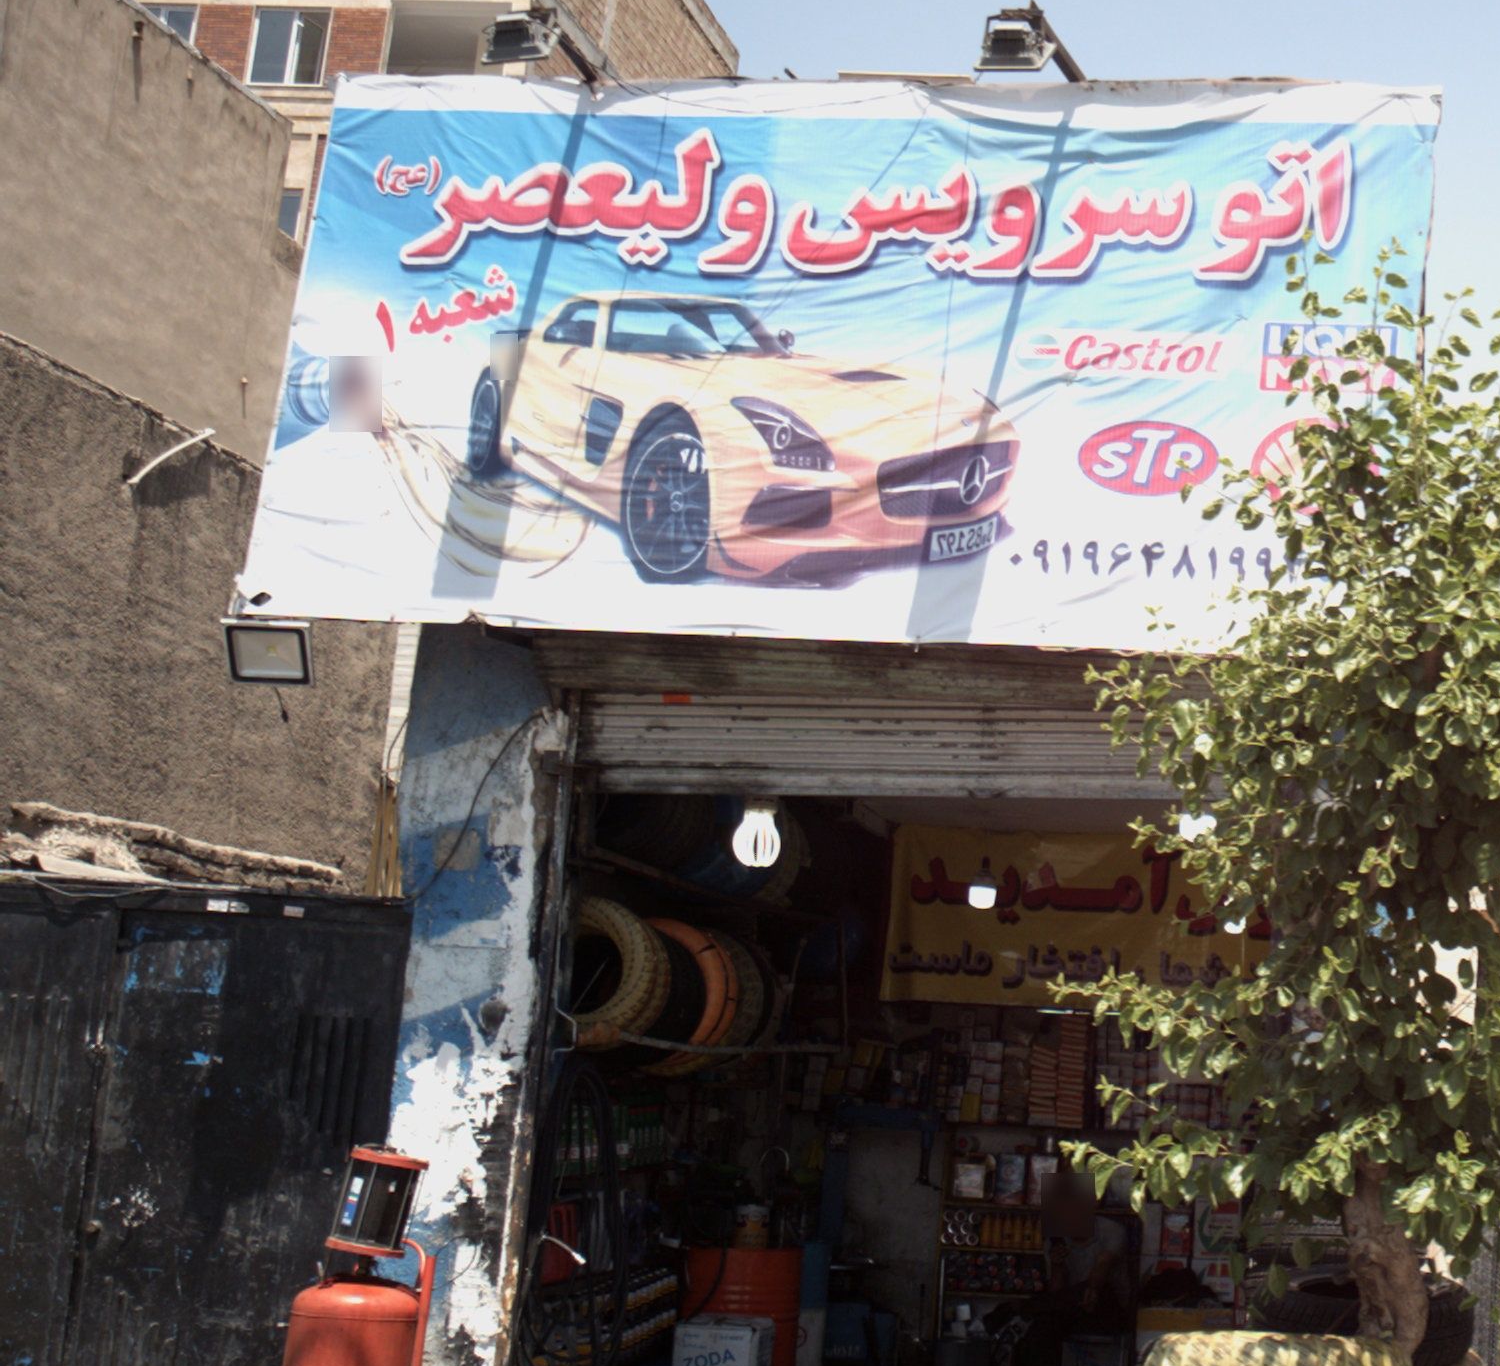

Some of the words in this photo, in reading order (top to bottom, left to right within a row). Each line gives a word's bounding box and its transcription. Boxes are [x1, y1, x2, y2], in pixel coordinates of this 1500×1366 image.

[782, 164, 1191, 276] سرویس
[1196, 139, 1352, 278] اتو
[375, 299, 396, 354] ۱
[408, 265, 517, 345] شعبه
[1063, 333, 1225, 375] Castrol
[1092, 429, 1205, 486] STP
[887, 939, 994, 977] ماست
